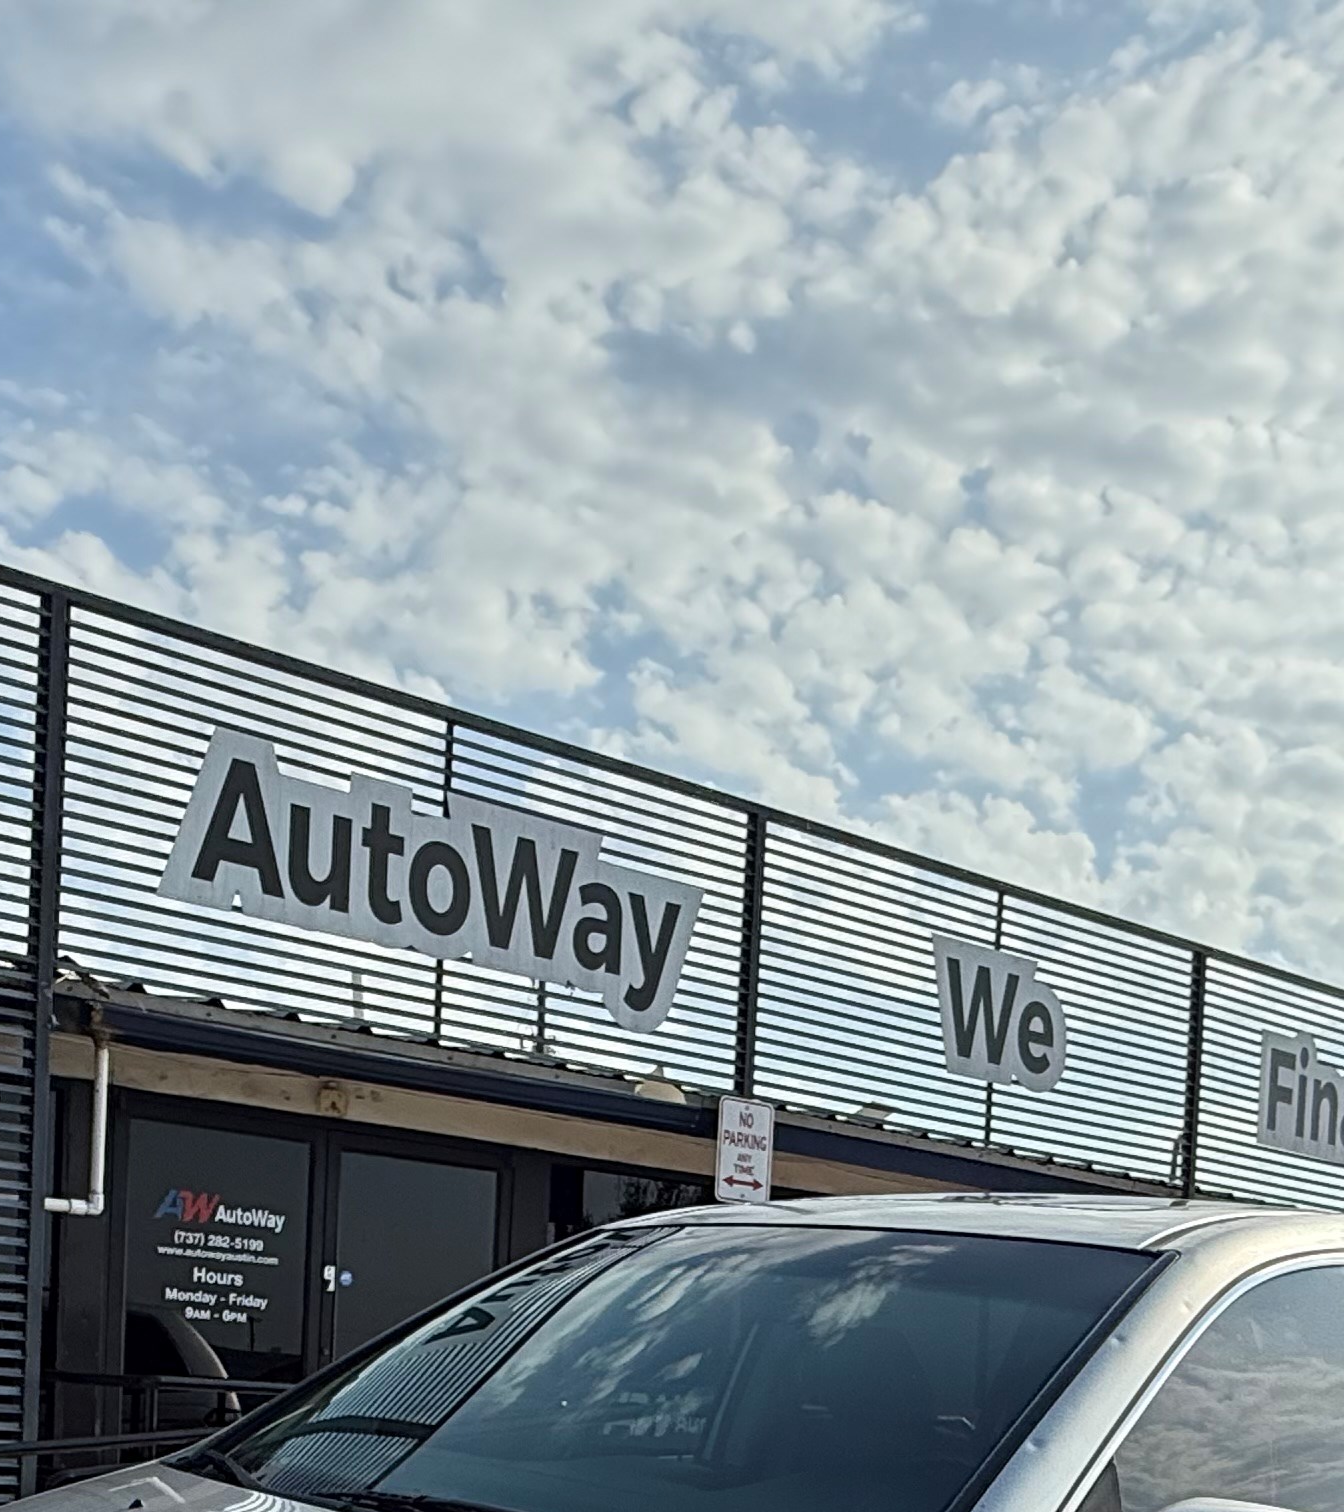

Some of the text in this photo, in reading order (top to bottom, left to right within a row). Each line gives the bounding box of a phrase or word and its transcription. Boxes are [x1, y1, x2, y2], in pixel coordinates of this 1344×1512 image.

[190, 757, 682, 1011] AutoWay
[946, 957, 1055, 1074] We
[739, 1111, 754, 1129] NO
[723, 1129, 767, 1151] PARKING
[737, 1153, 752, 1163] ANY
[733, 1163, 755, 1176] TIME
[154, 1189, 220, 1223] AW
[214, 1205, 285, 1233] AutoWay
[174, 1229, 264, 1252] (737) 282-5199
[157, 1246, 279, 1265] www.autowayaustin.com
[193, 1266, 244, 1287] Hours
[165, 1287, 218, 1306] Monday
[229, 1293, 268, 1310] Friday
[185, 1306, 211, 1320] 9AM
